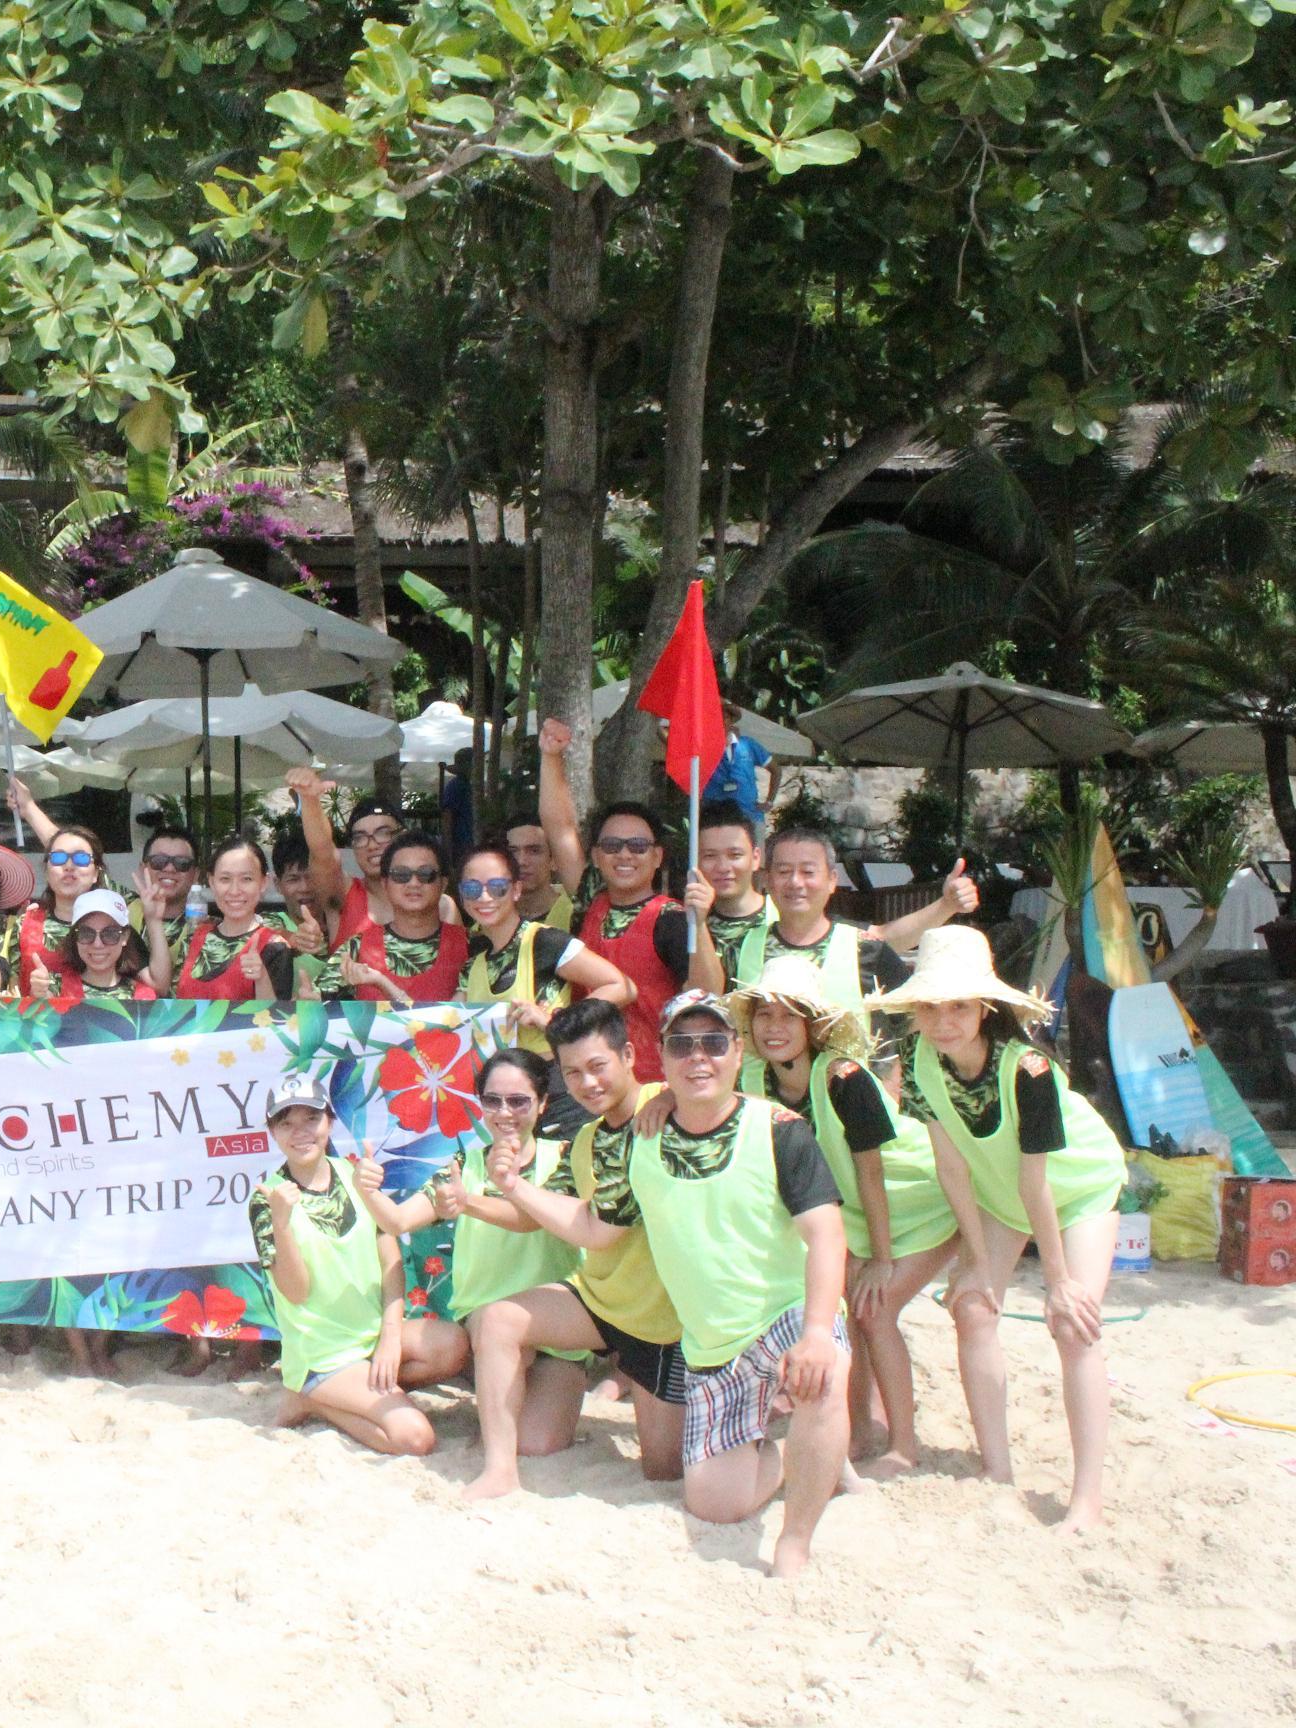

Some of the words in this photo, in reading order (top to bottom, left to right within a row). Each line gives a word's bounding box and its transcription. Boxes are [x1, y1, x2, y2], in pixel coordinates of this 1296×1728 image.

[213, 1137, 265, 1155] Asia
[25, 1153, 95, 1176] Spirits
[96, 1179, 193, 1216] TRIP
